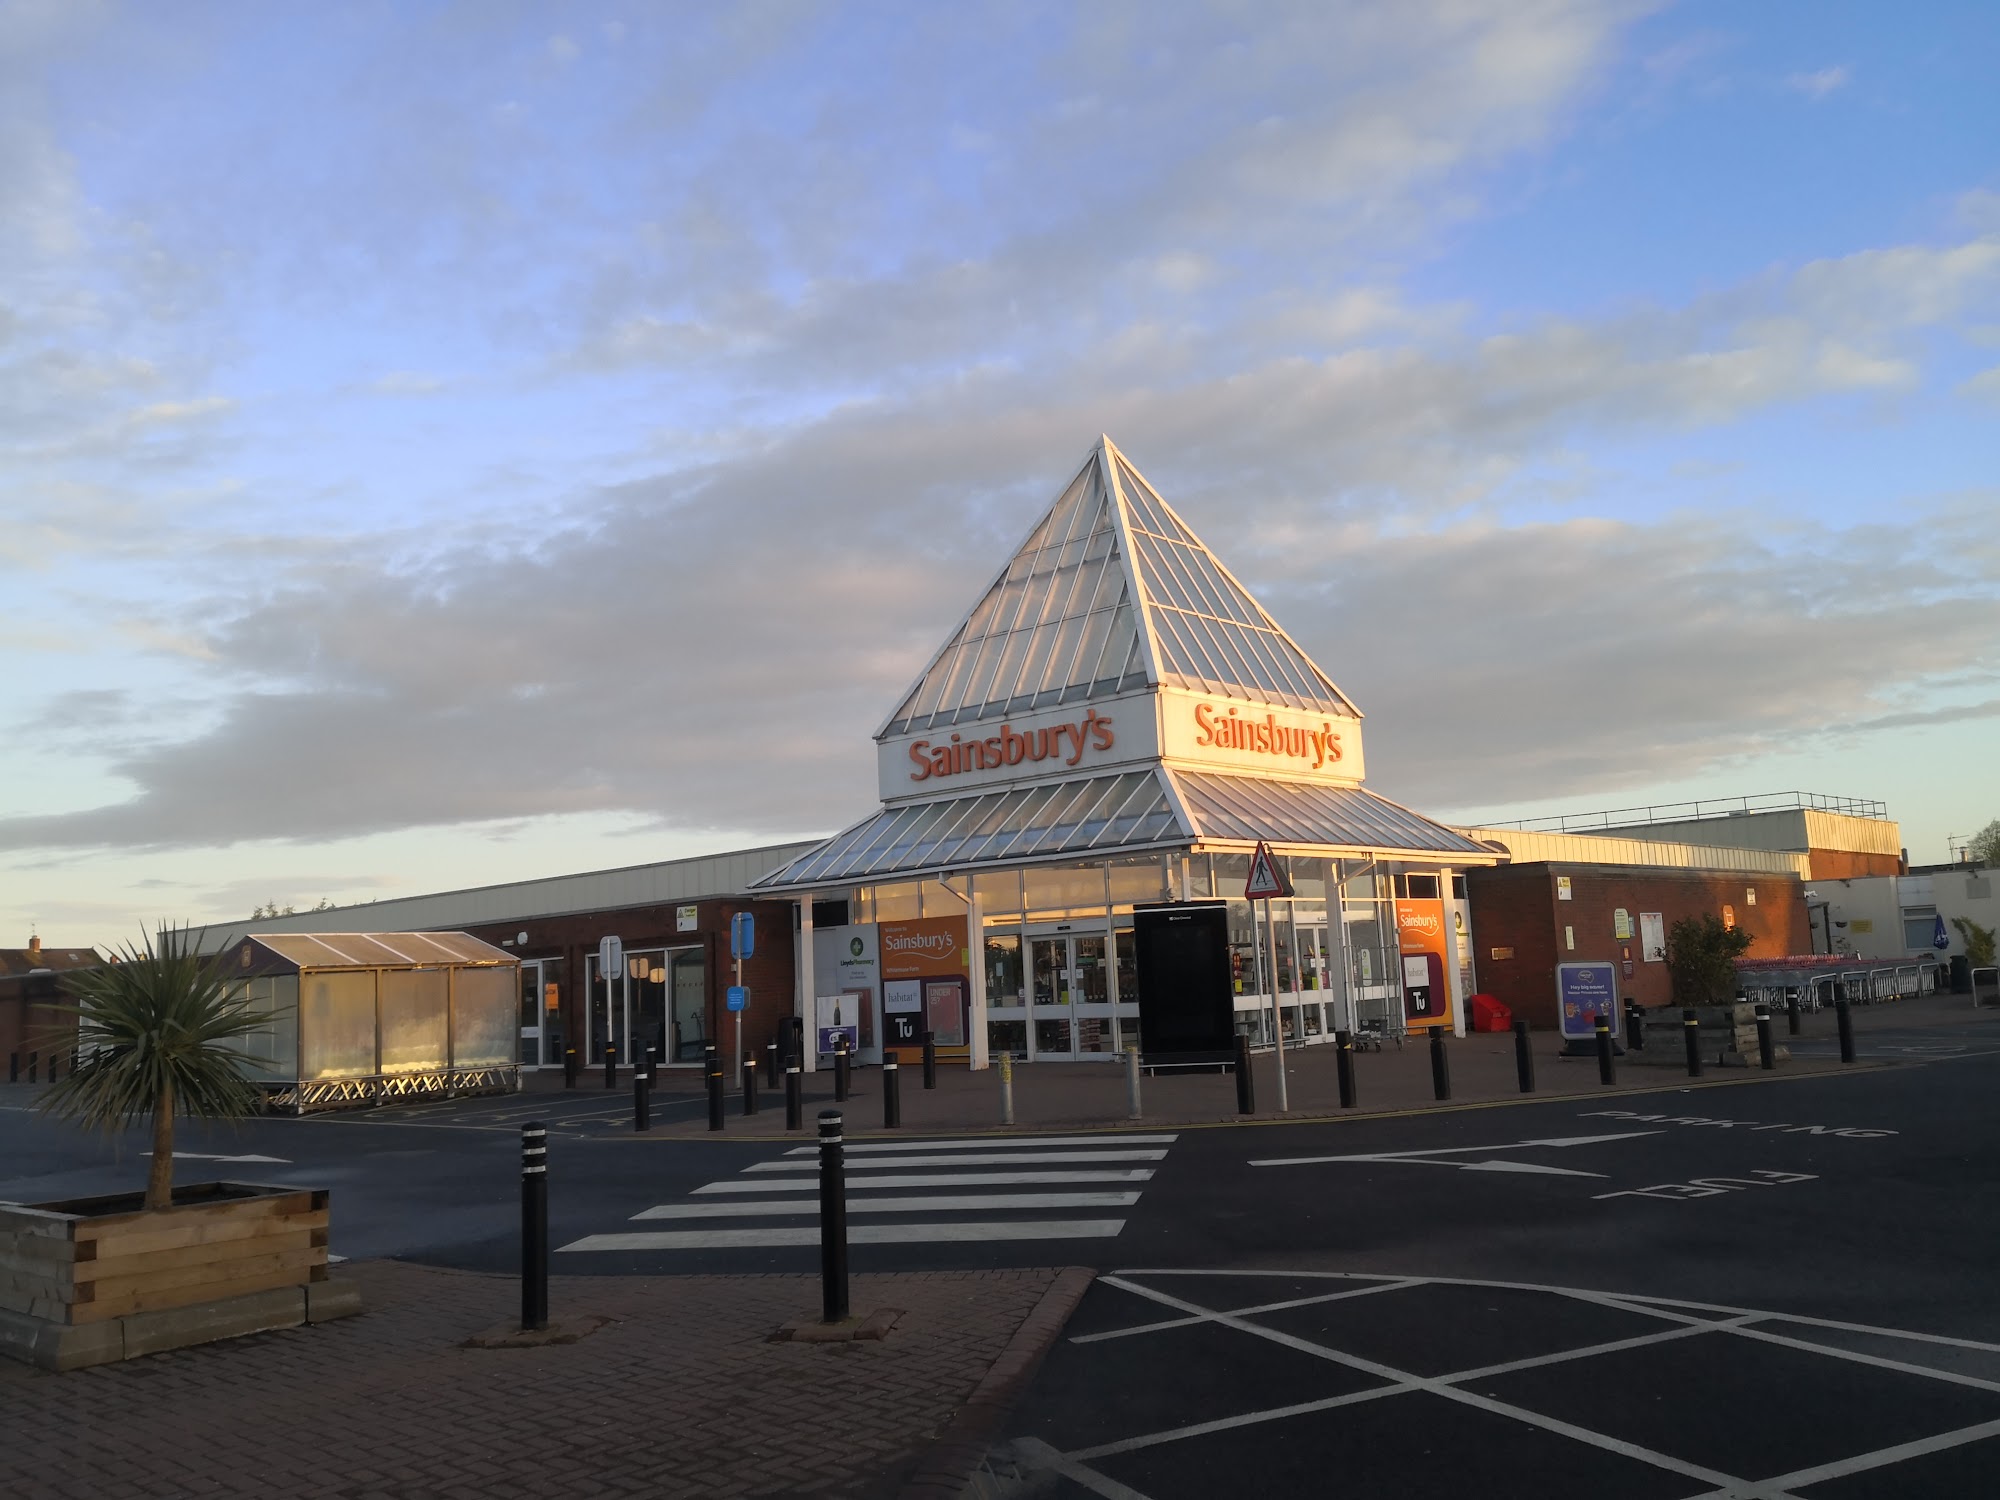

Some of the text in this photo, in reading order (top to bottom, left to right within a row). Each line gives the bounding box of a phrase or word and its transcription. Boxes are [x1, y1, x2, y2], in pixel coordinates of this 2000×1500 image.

[909, 708, 1115, 781] Sainsbury's
[1195, 703, 1343, 769] Sainsbury's
[1400, 914, 1437, 929] Sainsbury's
[885, 930, 953, 950] Sainsbury's
[888, 992, 913, 1002] habitat
[1412, 991, 1425, 1010] Tu
[895, 1018, 912, 1038] Tu
[1577, 1111, 1899, 1137] PARKING
[1590, 1170, 1819, 1199] FUEL
